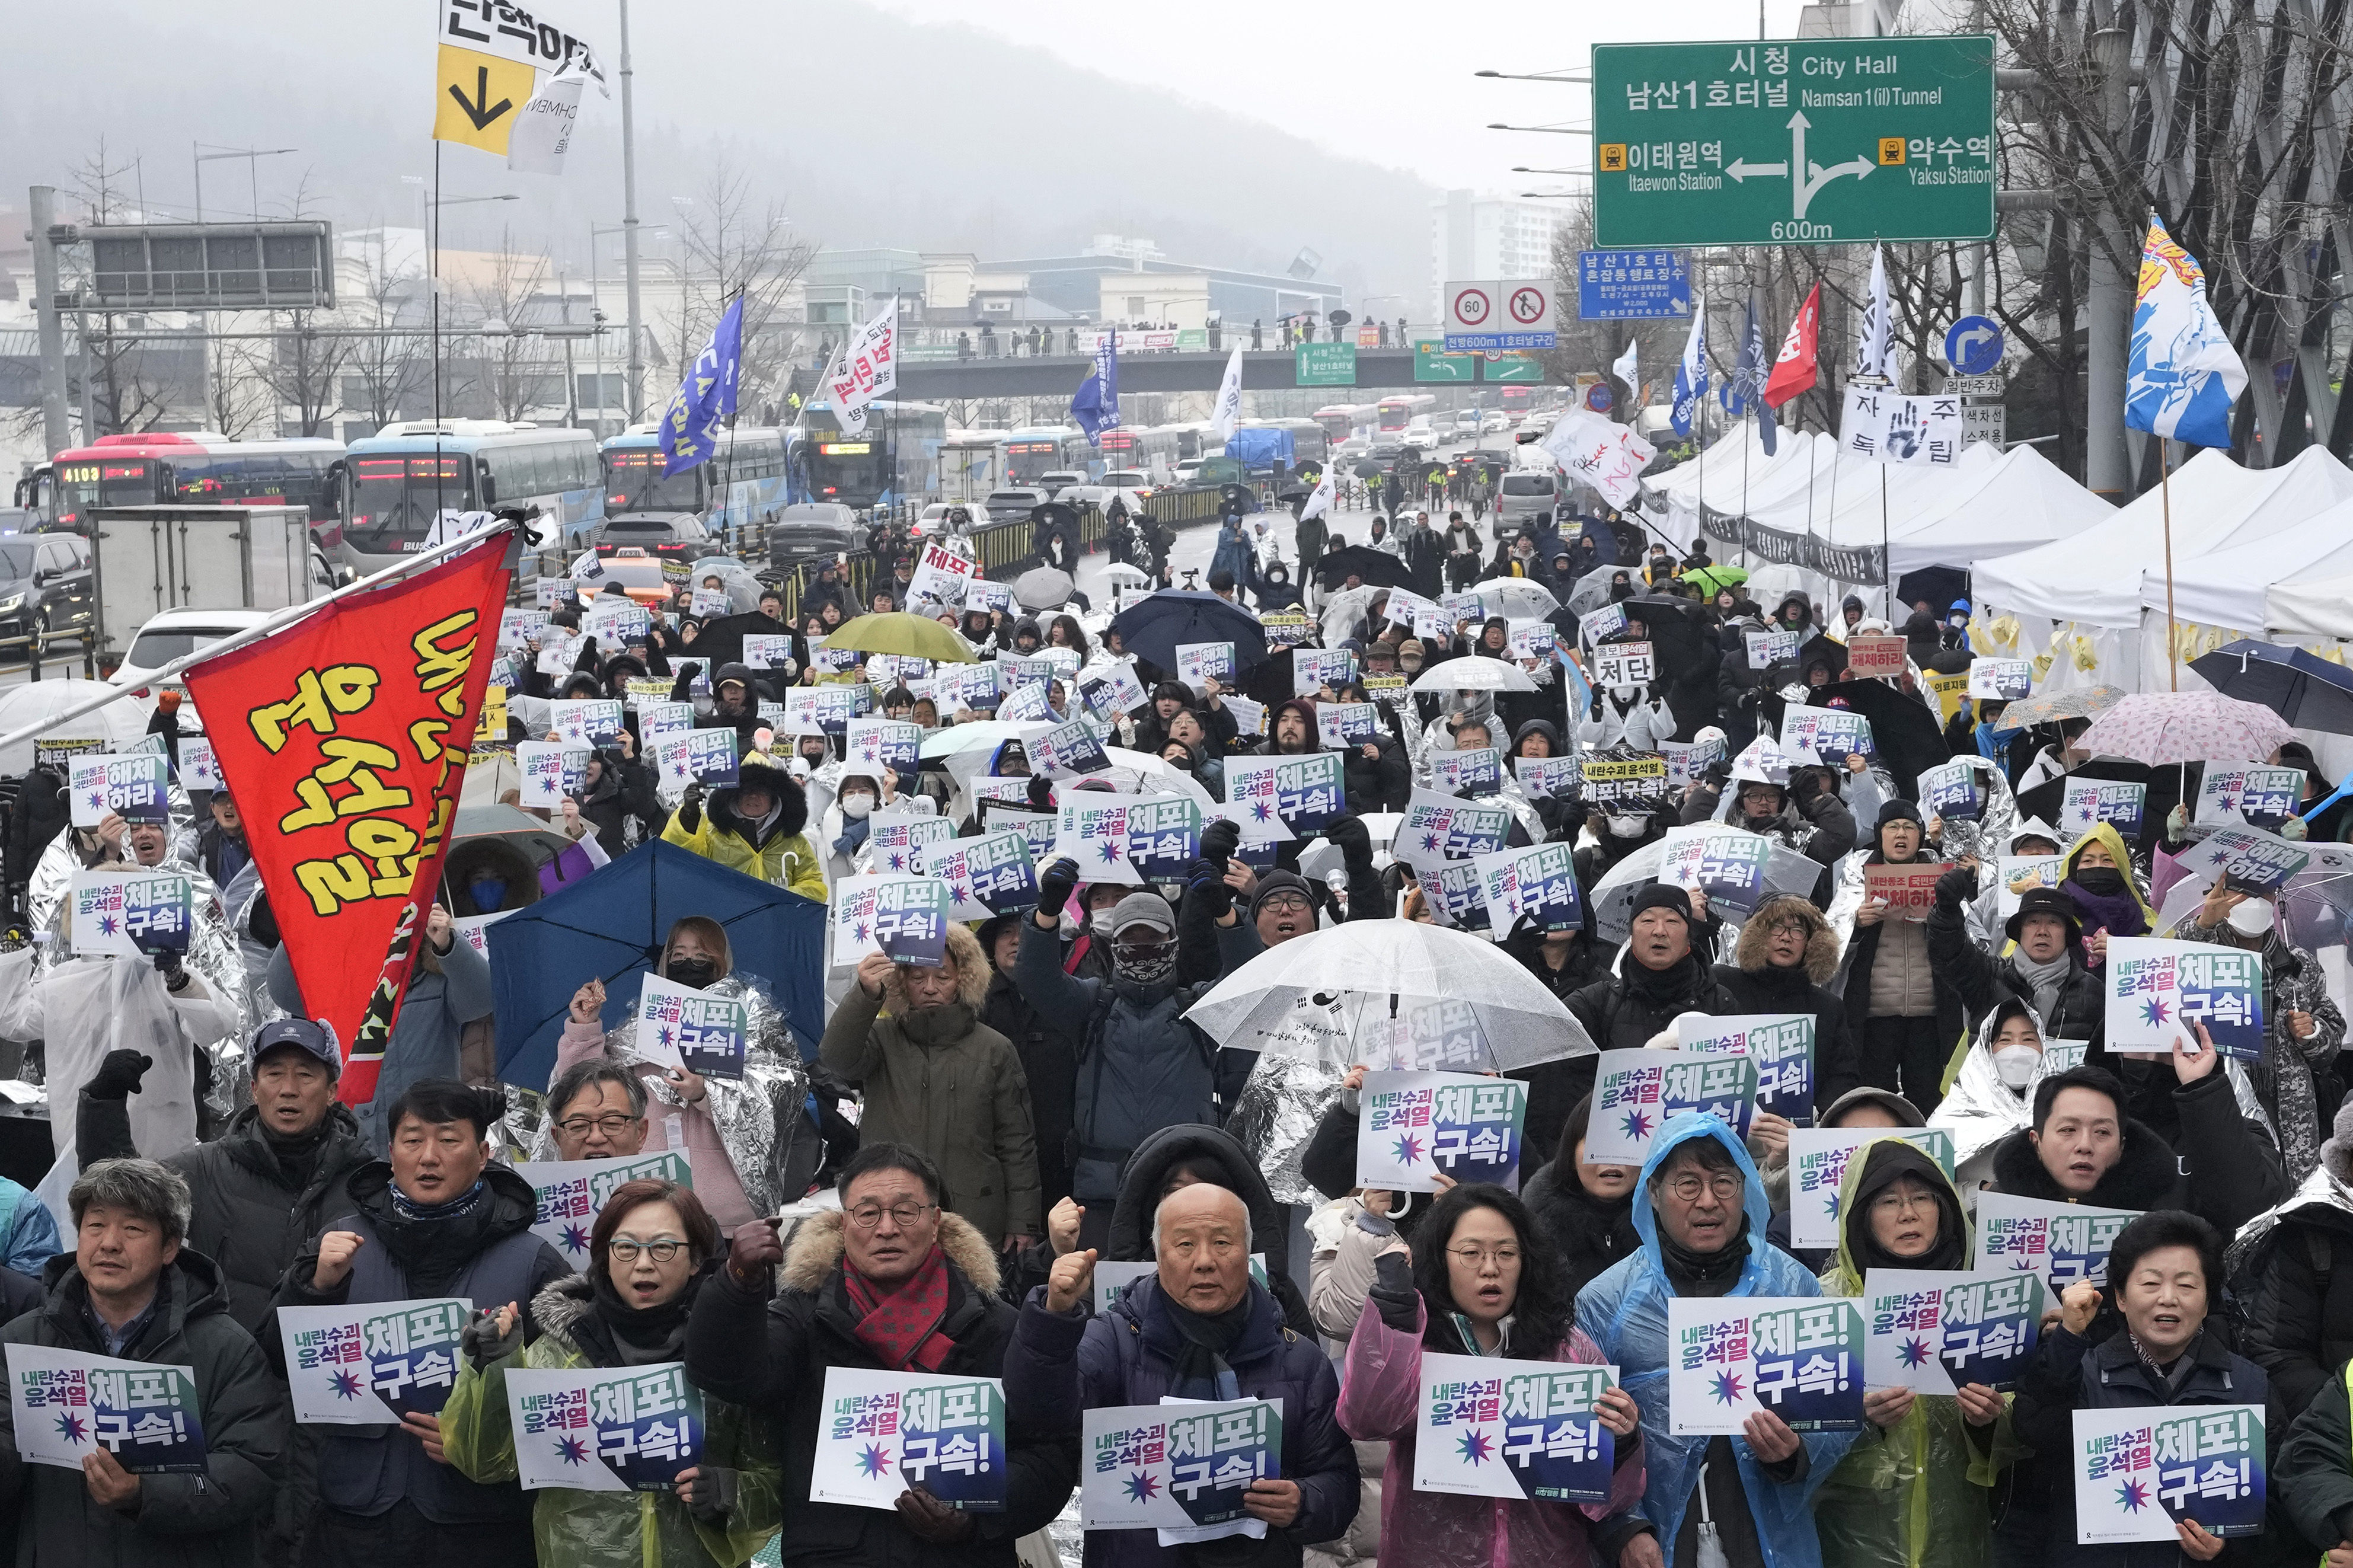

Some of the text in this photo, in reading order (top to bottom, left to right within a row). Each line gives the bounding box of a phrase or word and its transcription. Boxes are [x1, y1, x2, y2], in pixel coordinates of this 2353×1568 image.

[1729, 46, 1789, 75] 시청
[1802, 55, 1897, 79] City Hall
[1802, 89, 1862, 107] Namsan
[1892, 87, 1942, 105] Tunnel
[1630, 140, 1722, 171] 이태원역
[1909, 135, 1990, 165] 약수역
[1629, 172, 1722, 191] Itaewon Station
[1909, 165, 1991, 186] Yaksu Station
[1771, 221, 1832, 239] 600m
[1586, 267, 1684, 283] 혼잡통행료징수
[1465, 301, 1479, 313] 60
[1448, 334, 1553, 348] 전방600m 1호터널구간
[1947, 379, 2000, 394] 일반주차
[1857, 395, 1958, 420] 자 주
[1962, 408, 2002, 423] 색차선
[1962, 430, 2002, 443] 스전용
[1929, 440, 1952, 463] 립
[925, 545, 969, 574] 체포
[1620, 643, 1648, 655] 윤석열
[1851, 652, 1904, 667] 해체하라
[1600, 657, 1650, 684] 처단
[1787, 723, 1816, 733] 윤석열
[1818, 716, 1859, 733] 체포!
[659, 739, 687, 753] 내란수괴
[660, 747, 687, 765] 윤석열
[689, 730, 730, 756] 체포!
[1816, 734, 1856, 753] 구속!
[72, 765, 106, 781] 내란동조
[109, 756, 155, 785] 해체
[691, 751, 732, 777] 구속!
[1233, 768, 1273, 785] 내란수괴
[1278, 757, 1335, 792] 체포!
[1588, 762, 1658, 776] 내란수괴 윤석열
[2208, 771, 2245, 782] 내란수괴
[74, 775, 106, 790] 국민의힘
[109, 782, 155, 809] 하라
[247, 663, 420, 917] 윤석열
[1233, 780, 1273, 801] 윤석열
[2206, 780, 2242, 794] 윤석열
[2245, 772, 2298, 793] 체포!
[1081, 807, 1126, 822] 내란수괴
[1129, 800, 1191, 834] 체포!
[1280, 786, 1336, 822] 구속!
[1413, 805, 1454, 818] 내란수괴
[2241, 794, 2293, 816] 구속!
[1080, 820, 1125, 839] 윤석열
[1409, 815, 1450, 831] 윤석열
[1452, 810, 1507, 836] 체포!
[930, 851, 965, 871] 내란수괴
[967, 835, 1021, 873] 체포!
[1129, 832, 1190, 866] 구속!
[1486, 862, 1516, 884] 내란수괴
[1516, 845, 1573, 886] 체포!
[79, 884, 122, 899] 내란수괴
[126, 878, 184, 908] 체포!
[973, 863, 1027, 901] 구속!
[1489, 876, 1518, 900] 윤석열
[1870, 876, 1941, 886] 내란동조 국민의
[79, 896, 122, 915] 윤석열
[842, 887, 876, 908] 내란수괴
[877, 882, 940, 912] 체포!
[1523, 874, 1579, 915] 구속!
[127, 906, 184, 937] 구속!
[841, 900, 874, 924] 윤석열
[876, 912, 937, 943] 구속!
[2117, 955, 2175, 975] 내란수괴
[2180, 955, 2252, 989] 체포!
[2116, 970, 2175, 997] 윤석열
[646, 1005, 680, 1023] 윤석열
[647, 994, 682, 1008] 내란수괴
[681, 999, 738, 1029] 체포!
[2183, 992, 2253, 1027] 구속!
[677, 1030, 736, 1057] 구속!
[1750, 1019, 1817, 1064] 체포!
[1602, 1066, 1662, 1087] 내란수괴
[1665, 1060, 1748, 1101] 체포!
[1372, 1088, 1432, 1108] 내란수괴
[1436, 1086, 1516, 1125] 체포!
[1600, 1083, 1659, 1109] 윤석열
[1371, 1106, 1430, 1131] 윤석열
[1435, 1127, 1512, 1168] 구속!
[1987, 1218, 2047, 1233] 내란수괴
[1986, 1234, 2045, 1255] 윤석열
[1875, 1289, 1942, 1311] 내란수괴
[1945, 1276, 2034, 1326] 체포!
[366, 1304, 461, 1358] 체포!
[1681, 1317, 1748, 1345] 내란수괴
[1754, 1304, 1848, 1356] 체포!
[1873, 1307, 1939, 1336] 윤석열
[294, 1323, 360, 1347] 내란수괴
[1943, 1319, 2028, 1369] 구속!
[297, 1340, 363, 1370] 윤석열
[1681, 1337, 1748, 1371] 윤석열
[21, 1369, 86, 1385] 내란수괴
[1433, 1378, 1501, 1400] 내란수괴
[1757, 1351, 1848, 1404] 구속!
[25, 1386, 88, 1407] 윤석열
[90, 1372, 178, 1409] 체포!
[521, 1388, 587, 1411] 내란수괴
[593, 1371, 688, 1426] 체포!
[836, 1392, 900, 1414] 내란수괴
[1505, 1372, 1603, 1419] 체포!
[523, 1407, 588, 1435] 윤석열
[903, 1385, 989, 1433] 체포!
[1431, 1398, 1499, 1426] 윤석열
[92, 1411, 186, 1453] 구속!
[833, 1411, 898, 1441] 윤석열
[1096, 1423, 1165, 1449] 내란수괴
[1171, 1407, 1267, 1459] 체포!
[2157, 1411, 2249, 1464] 체포!
[600, 1418, 691, 1469] 구속!
[1505, 1419, 1599, 1468] 구속!
[2087, 1426, 2151, 1455] 내란수괴
[902, 1432, 988, 1481] 구속!
[1095, 1441, 1164, 1473] 윤석열
[2088, 1445, 2151, 1480] 윤석열
[2160, 1457, 2250, 1510] 구속!
